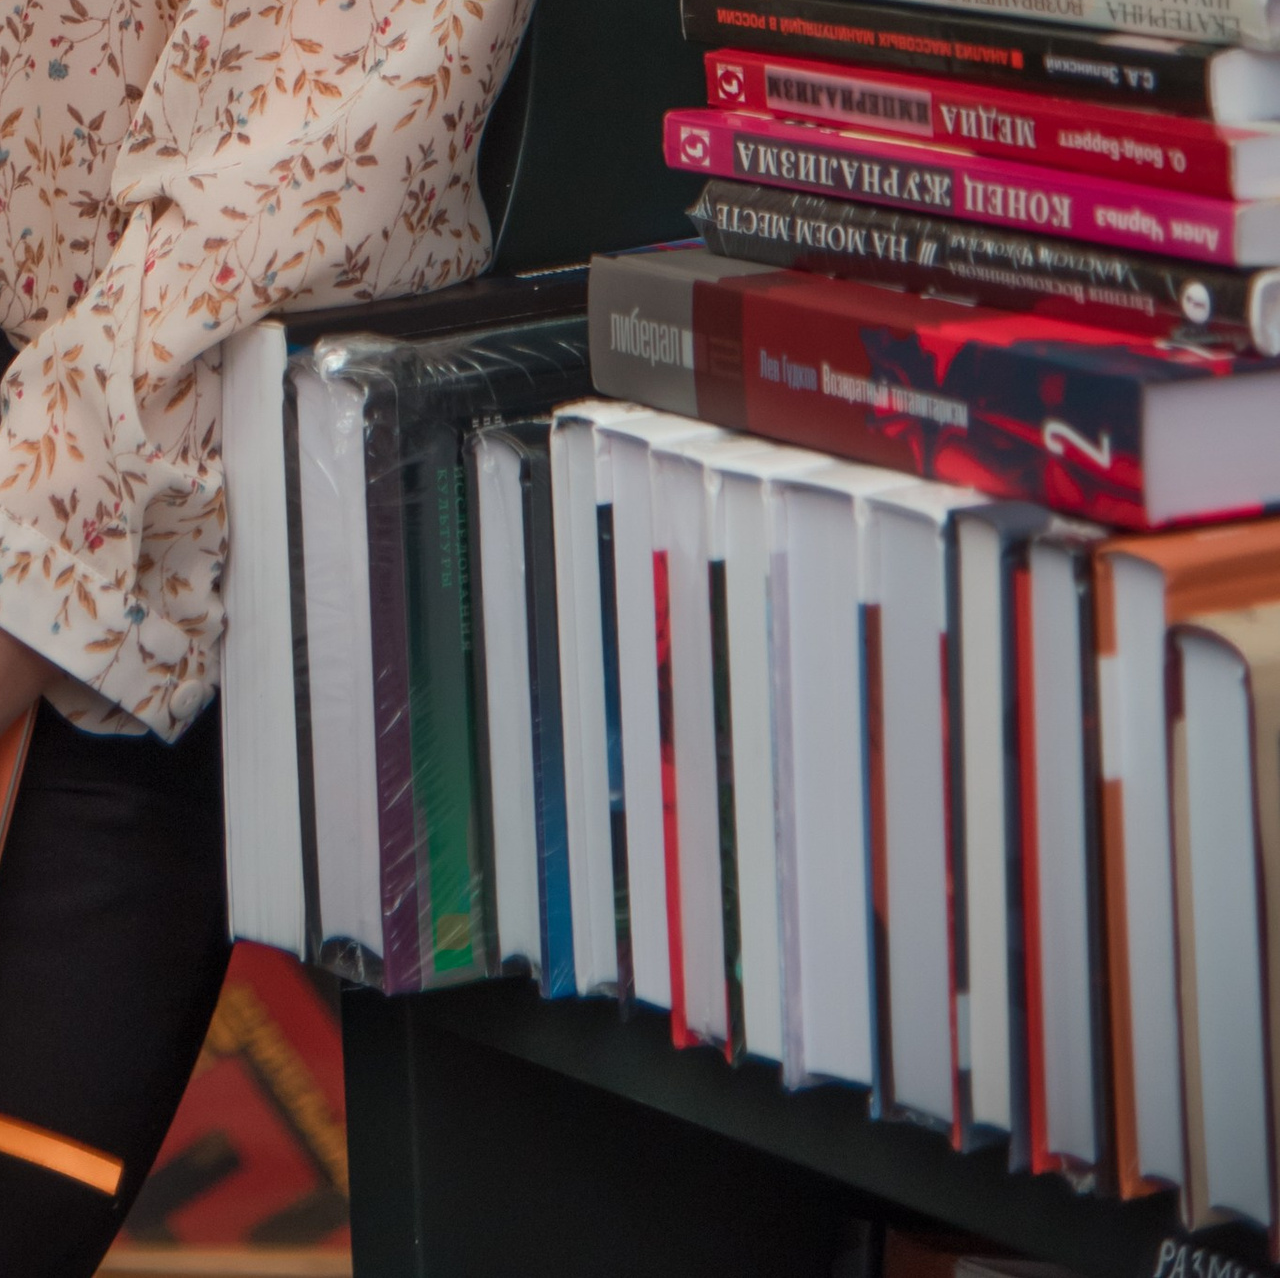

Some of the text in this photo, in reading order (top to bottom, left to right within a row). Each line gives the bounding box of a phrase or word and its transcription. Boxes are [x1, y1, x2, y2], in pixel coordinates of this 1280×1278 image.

[716, 7, 1011, 65] АНАЛИЗ МАССОВЫХ МАНИПУЛЯЦИЙ В РОССИИ
[1106, 1, 1240, 36] ЕКАТЕРИНА
[1045, 56, 1156, 92] С.А. Зелинский
[767, 75, 1038, 149] МЕДИА ИМПЕРИАЛИЗМ
[1057, 128, 1188, 174] О. Бойд-Барретт
[736, 140, 1074, 231] КОНЕЦ ЖУРНАЛИЗМА
[716, 203, 910, 263] НА МОЕМ МЕСТЕ
[1093, 203, 1220, 253] Алек Чарльз
[610, 305, 680, 367] либерал
[760, 347, 780, 383] Лев
[781, 354, 819, 393] Гудков
[821, 359, 889, 410] Возвратный
[889, 383, 970, 429] тоталитаризм
[436, 467, 453, 589] КУЛЬТУРЫ
